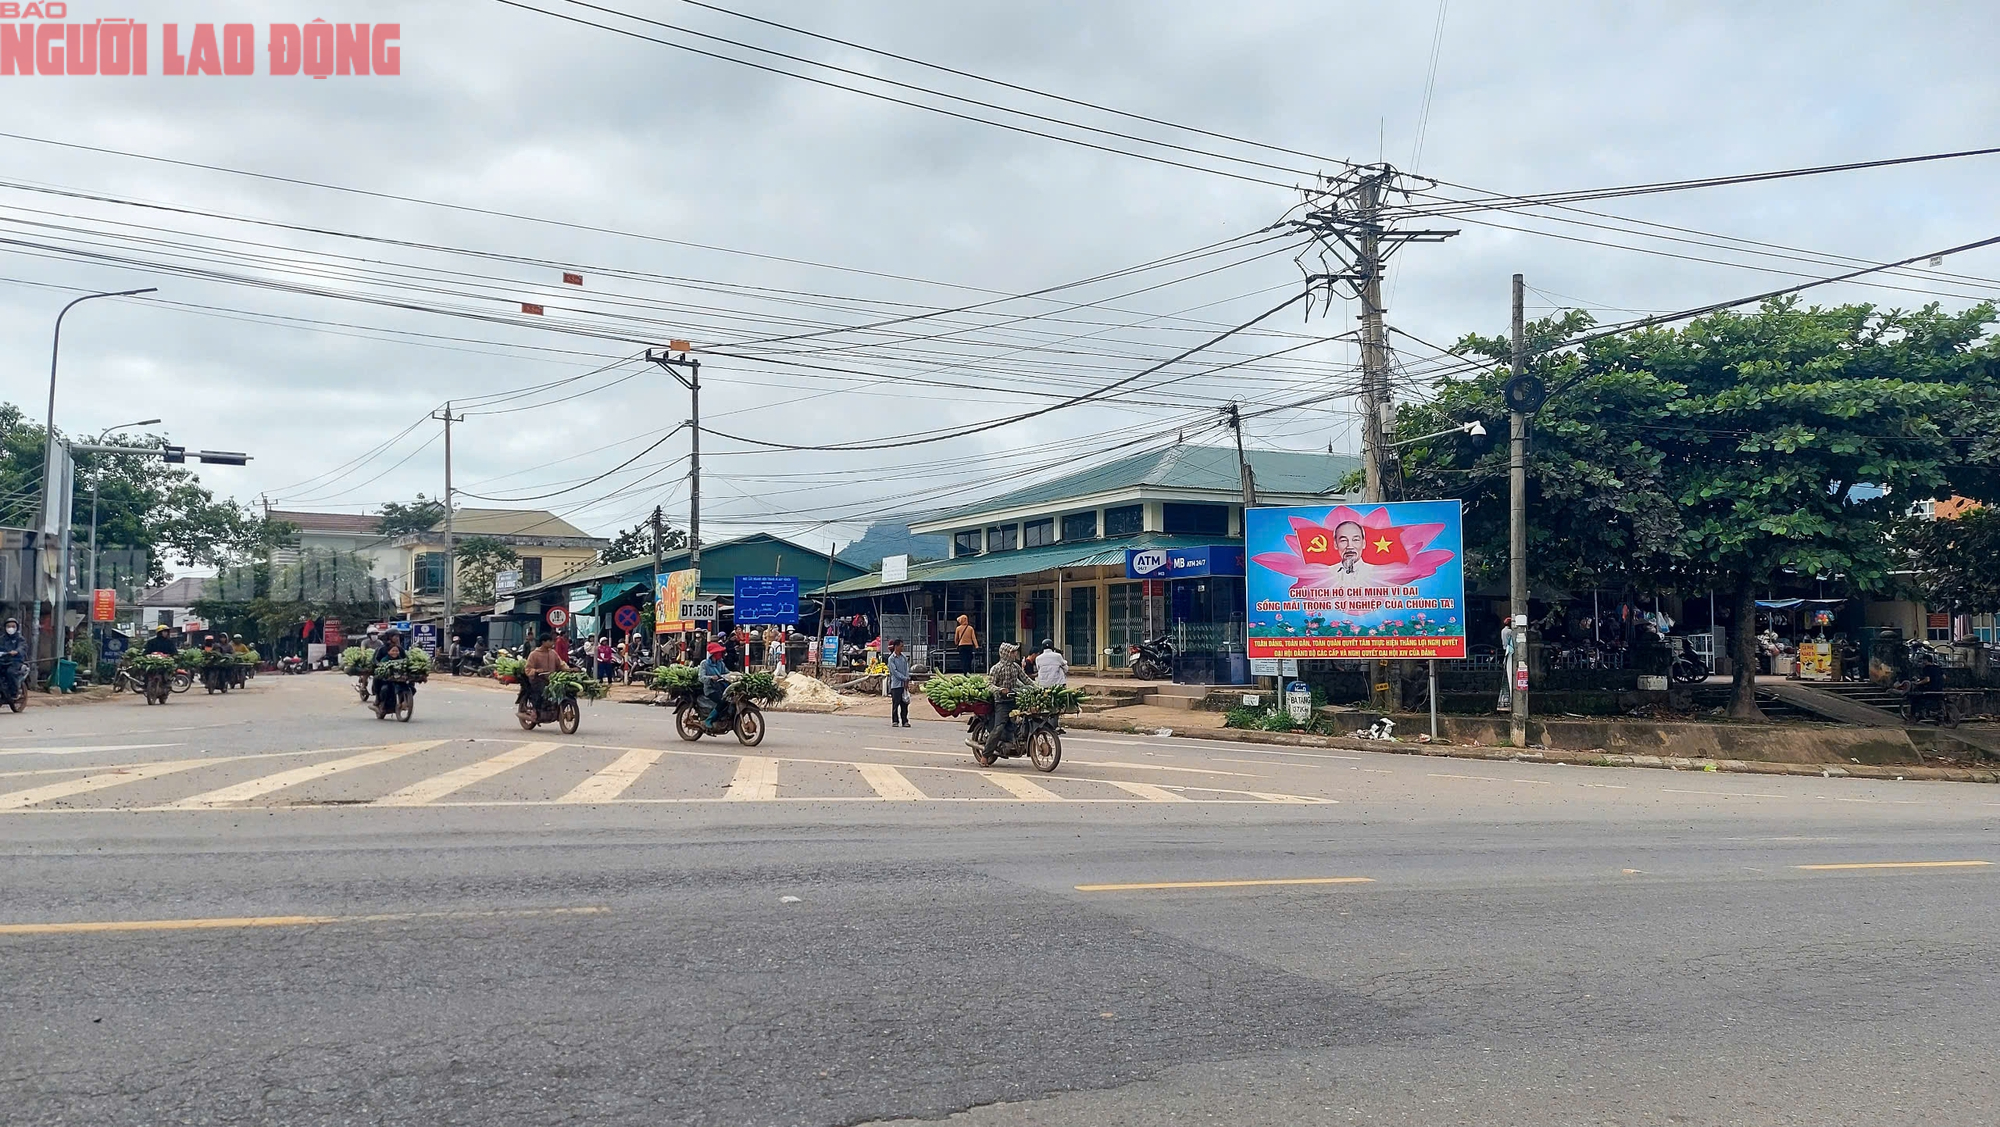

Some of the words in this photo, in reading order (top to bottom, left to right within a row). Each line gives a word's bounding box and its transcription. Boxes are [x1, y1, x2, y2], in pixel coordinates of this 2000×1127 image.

[1137, 556, 1160, 565] ATM
[1174, 558, 1185, 569] MB
[1290, 587, 1307, 598] CHỦ
[1310, 588, 1329, 599] TỊCH
[1332, 587, 1344, 597] HỒ
[1347, 587, 1362, 597] CHÍ
[1365, 587, 1388, 596] MINH
[1391, 585, 1400, 596] VĨ
[1403, 587, 1418, 597] ĐẠI
[1257, 599, 1280, 610] SỐNG
[1284, 601, 1299, 610] MÃI
[1302, 601, 1331, 610] TRONG
[1334, 601, 1348, 611] SỰ
[1349, 600, 1381, 611] NGHIỆP
[1385, 599, 1402, 609] CỦA
[1406, 598, 1437, 608] CHÚNG
[1440, 599, 1454, 608] TA!
[681, 605, 713, 616] ĐT.586
